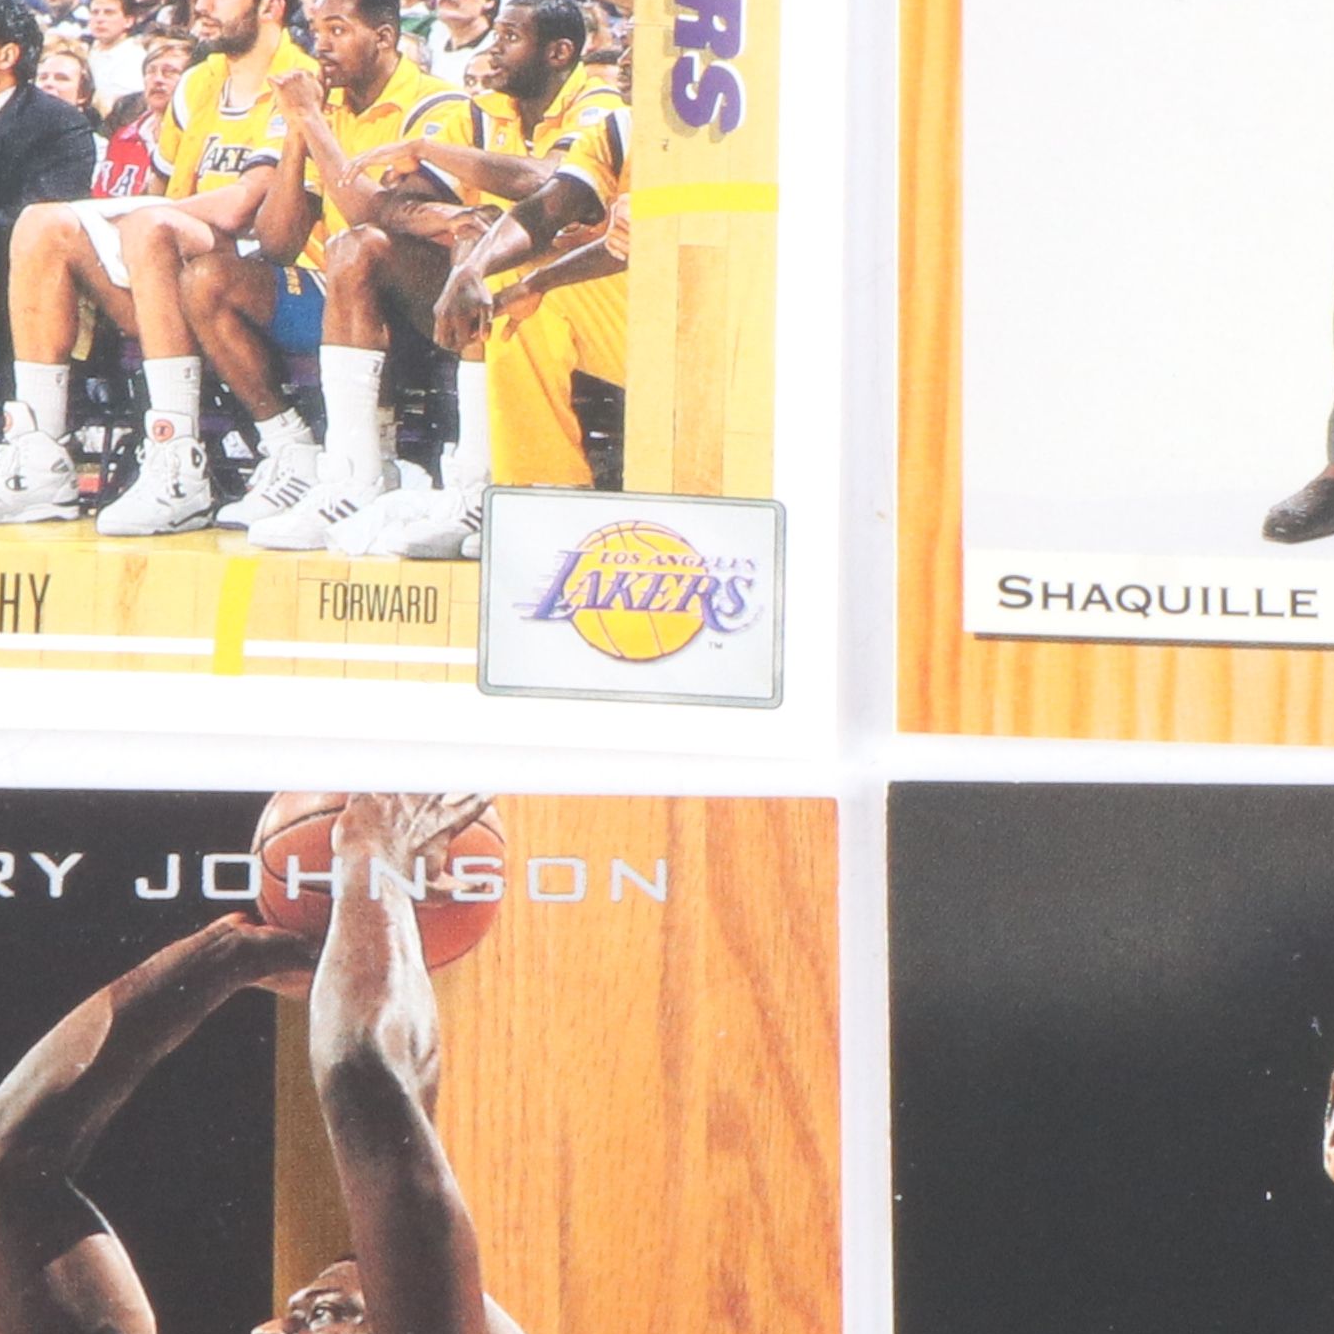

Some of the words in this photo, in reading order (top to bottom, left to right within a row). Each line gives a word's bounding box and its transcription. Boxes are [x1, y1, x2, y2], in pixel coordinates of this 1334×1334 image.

[600, 551, 641, 565] LOS
[318, 581, 440, 625] FORWARD
[527, 550, 757, 634] LAKERS
[996, 573, 1320, 620] SHAQUILLE
[134, 851, 669, 905] JOHNSON
